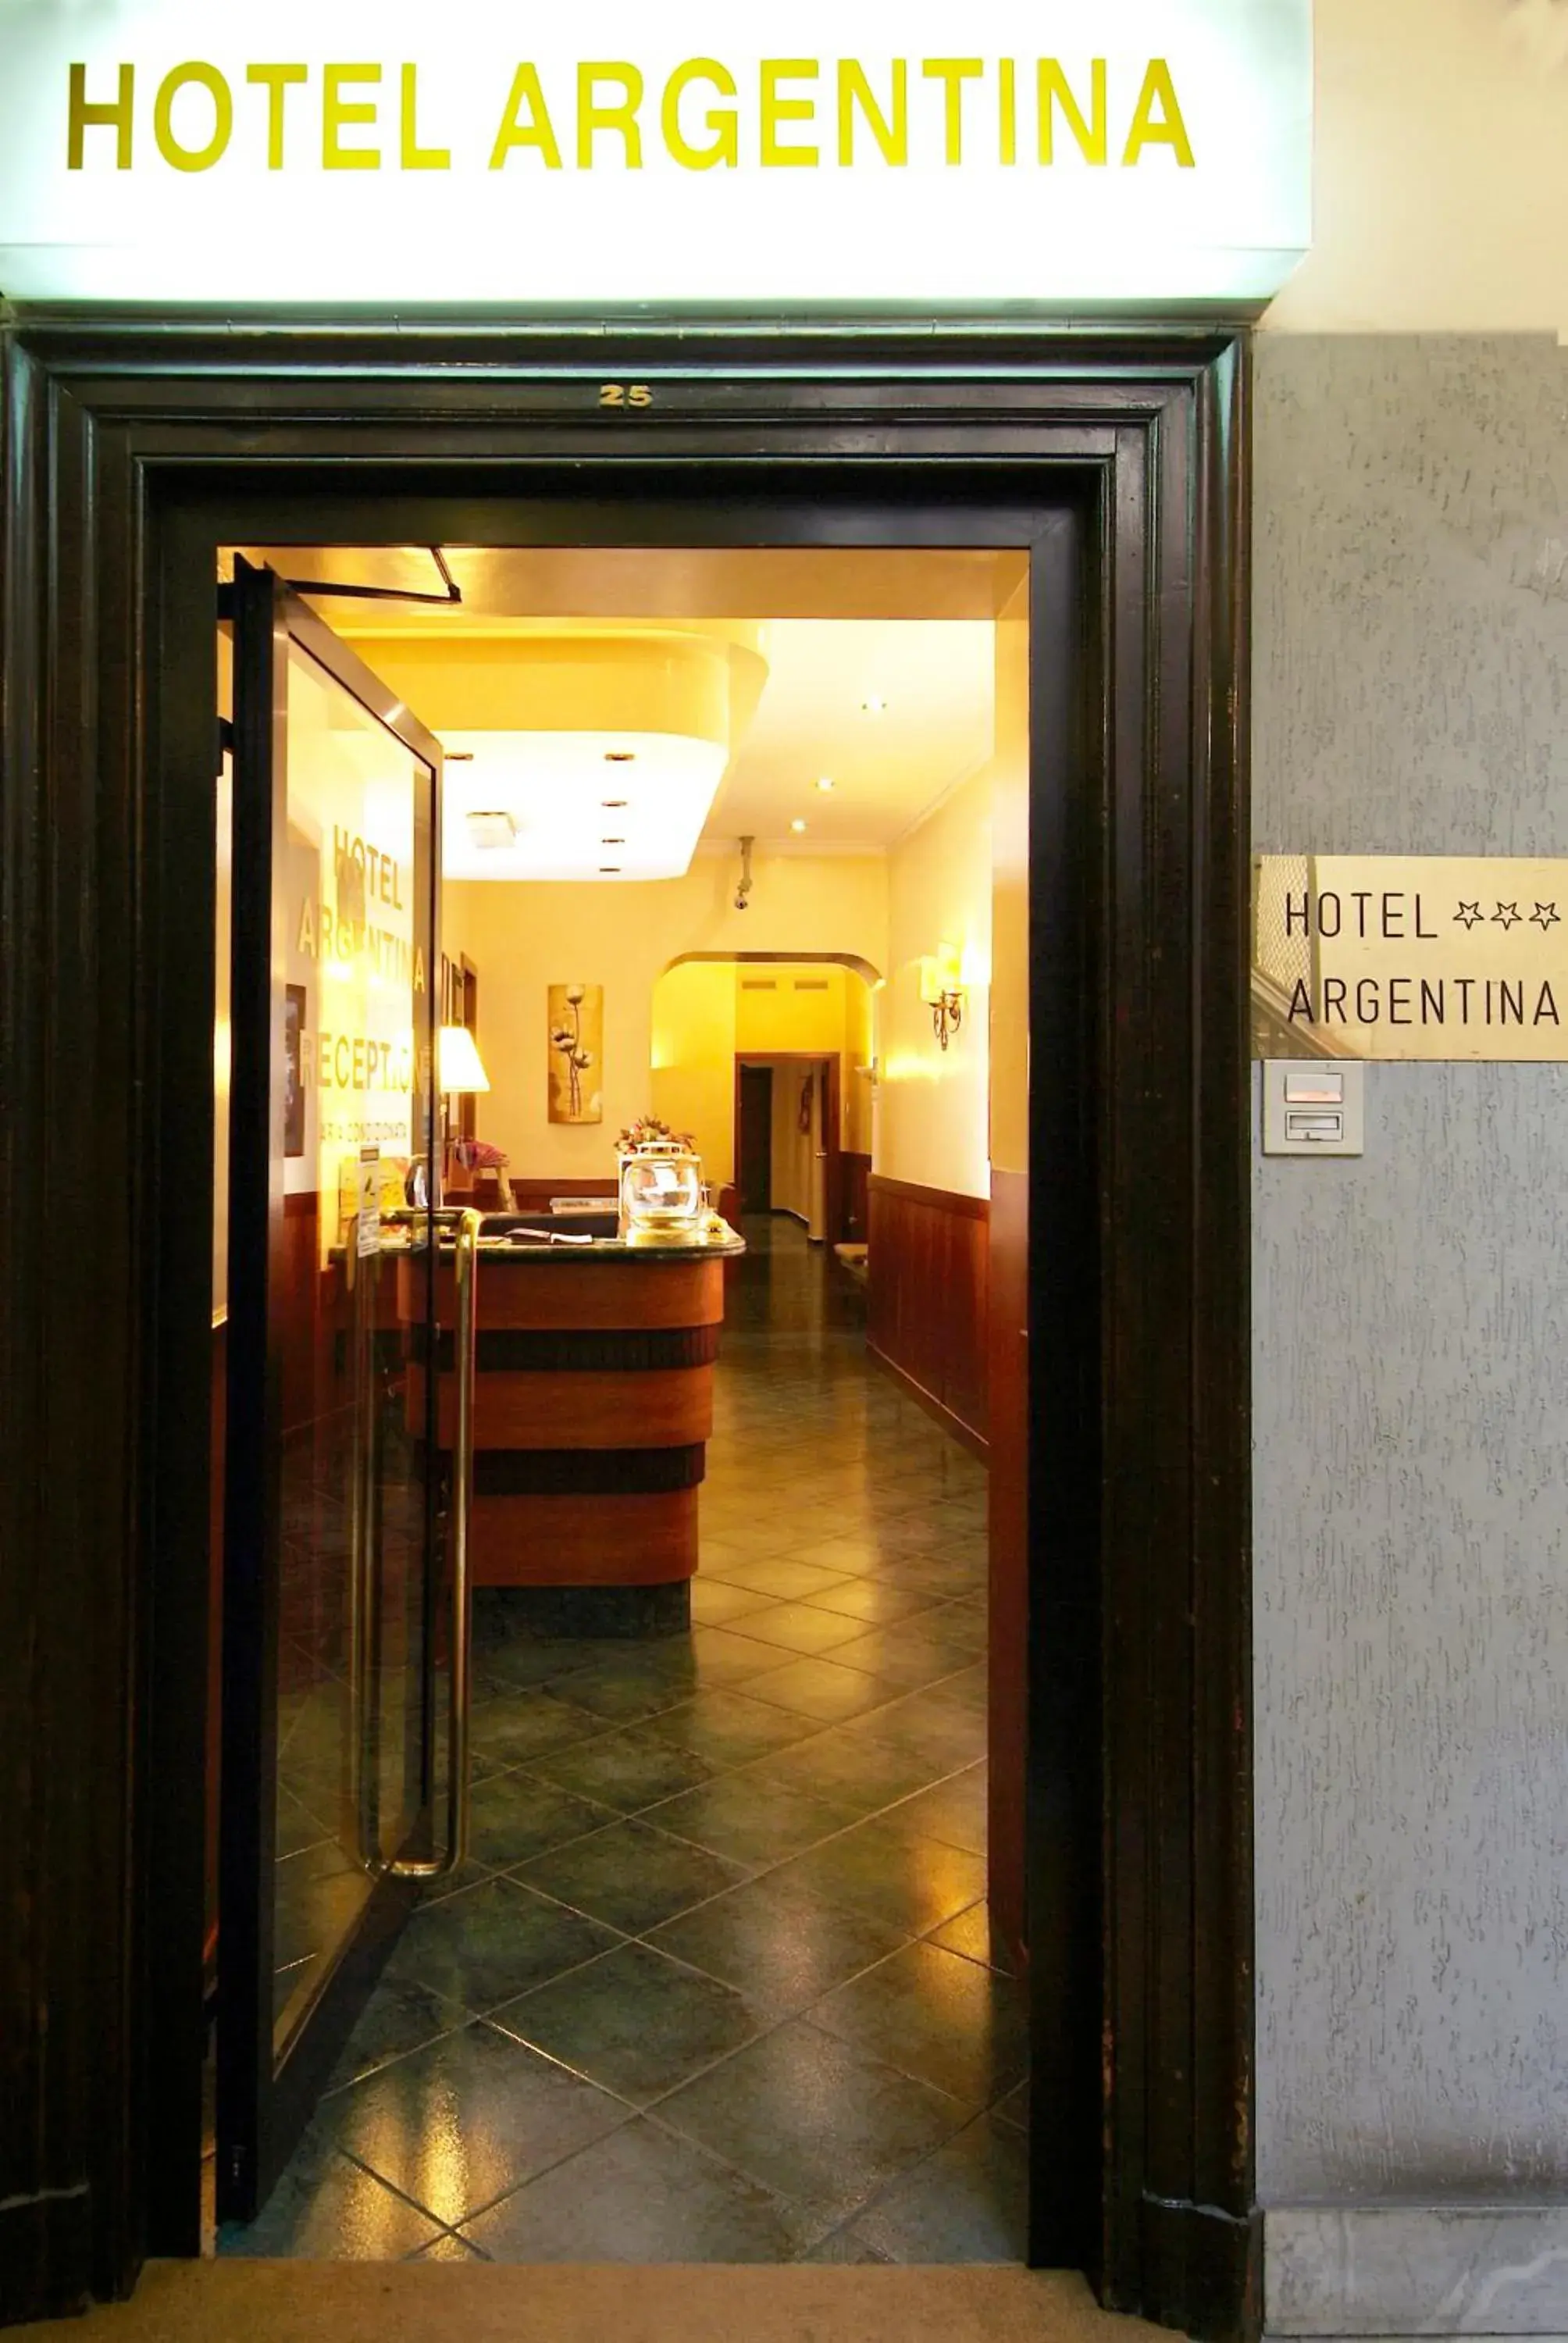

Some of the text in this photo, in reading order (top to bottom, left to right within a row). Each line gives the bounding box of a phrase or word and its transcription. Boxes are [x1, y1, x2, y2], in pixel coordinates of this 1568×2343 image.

[68, 58, 1195, 171] HOTEL ARGENTINA
[600, 384, 652, 406] 25
[333, 825, 402, 911] HOTEL
[297, 897, 425, 993] ARGNTINA
[1285, 892, 1438, 938] HOTEL
[1288, 979, 1560, 1025] ARGENTINA
